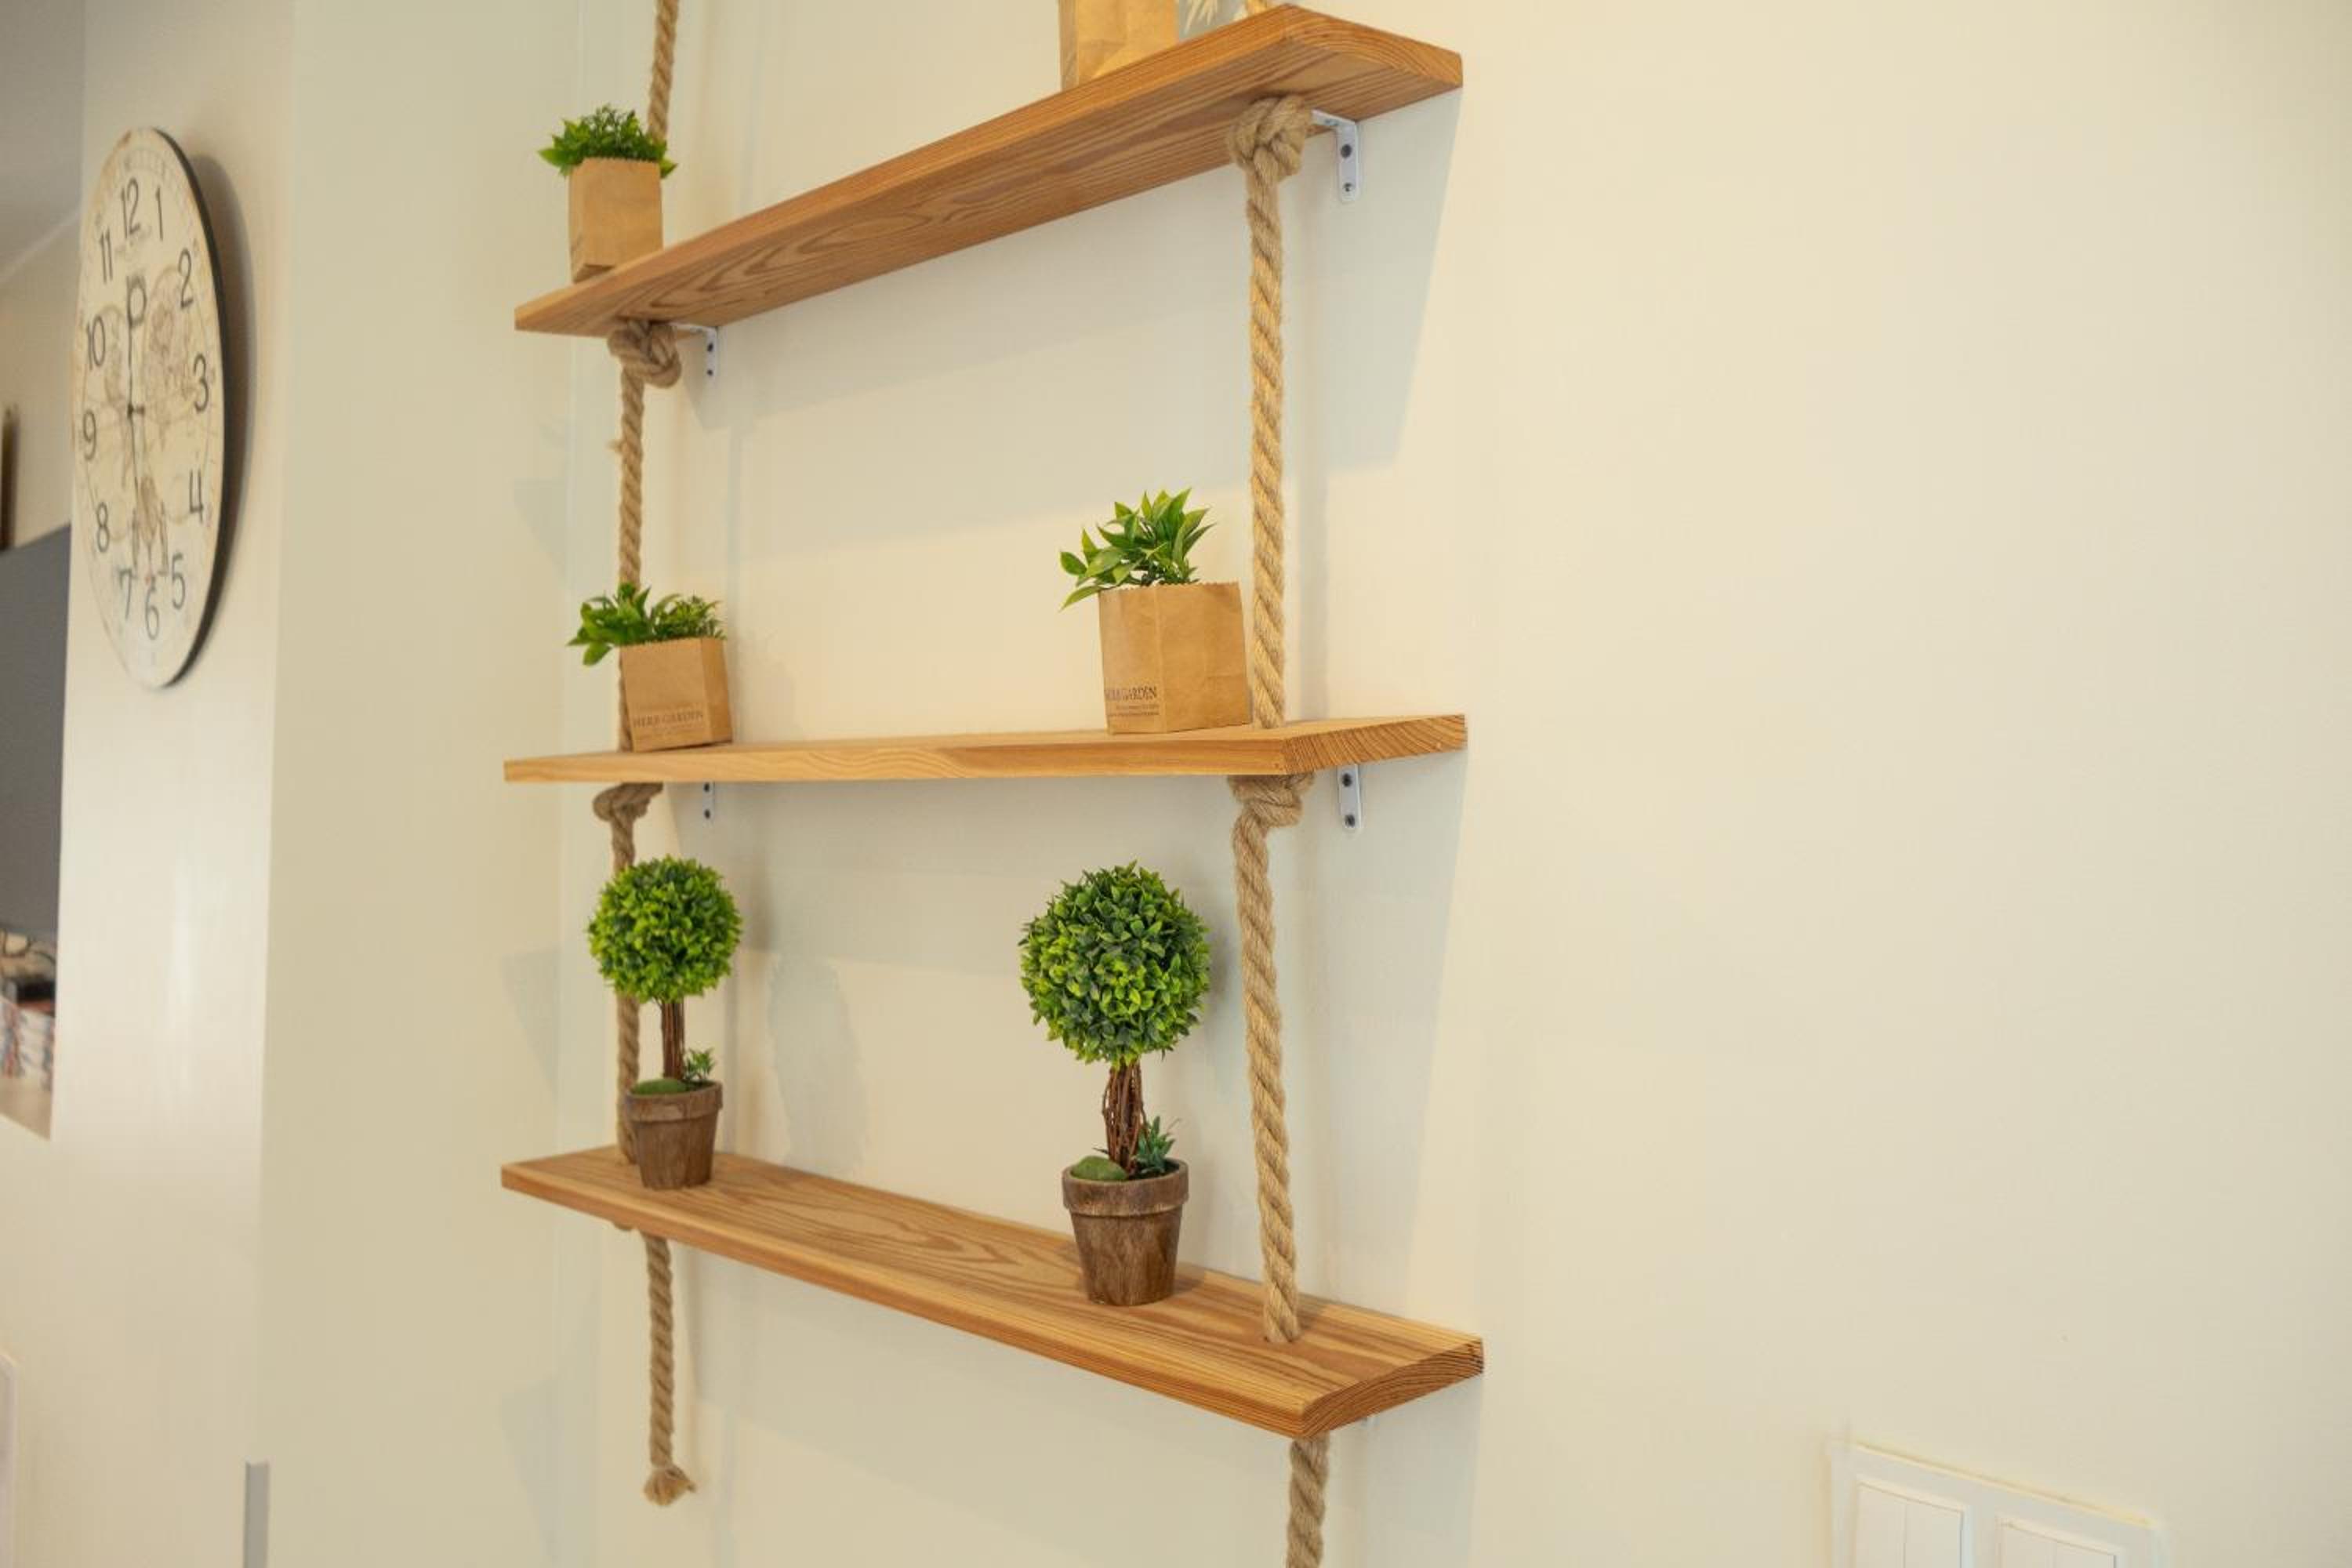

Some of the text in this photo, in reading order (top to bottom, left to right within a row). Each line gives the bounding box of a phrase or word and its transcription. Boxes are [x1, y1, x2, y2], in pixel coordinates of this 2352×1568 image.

[122, 178, 141, 238] 12
[156, 187, 163, 241] 1
[99, 228, 113, 284] 11
[178, 248, 193, 310] 2
[86, 315, 106, 370] 10
[193, 354, 209, 412] 3
[82, 410, 97, 461] 9
[189, 469, 204, 524] 4
[96, 503, 111, 553] 8
[119, 568, 134, 619] 7
[170, 553, 186, 610] 5
[145, 579, 159, 641] 6
